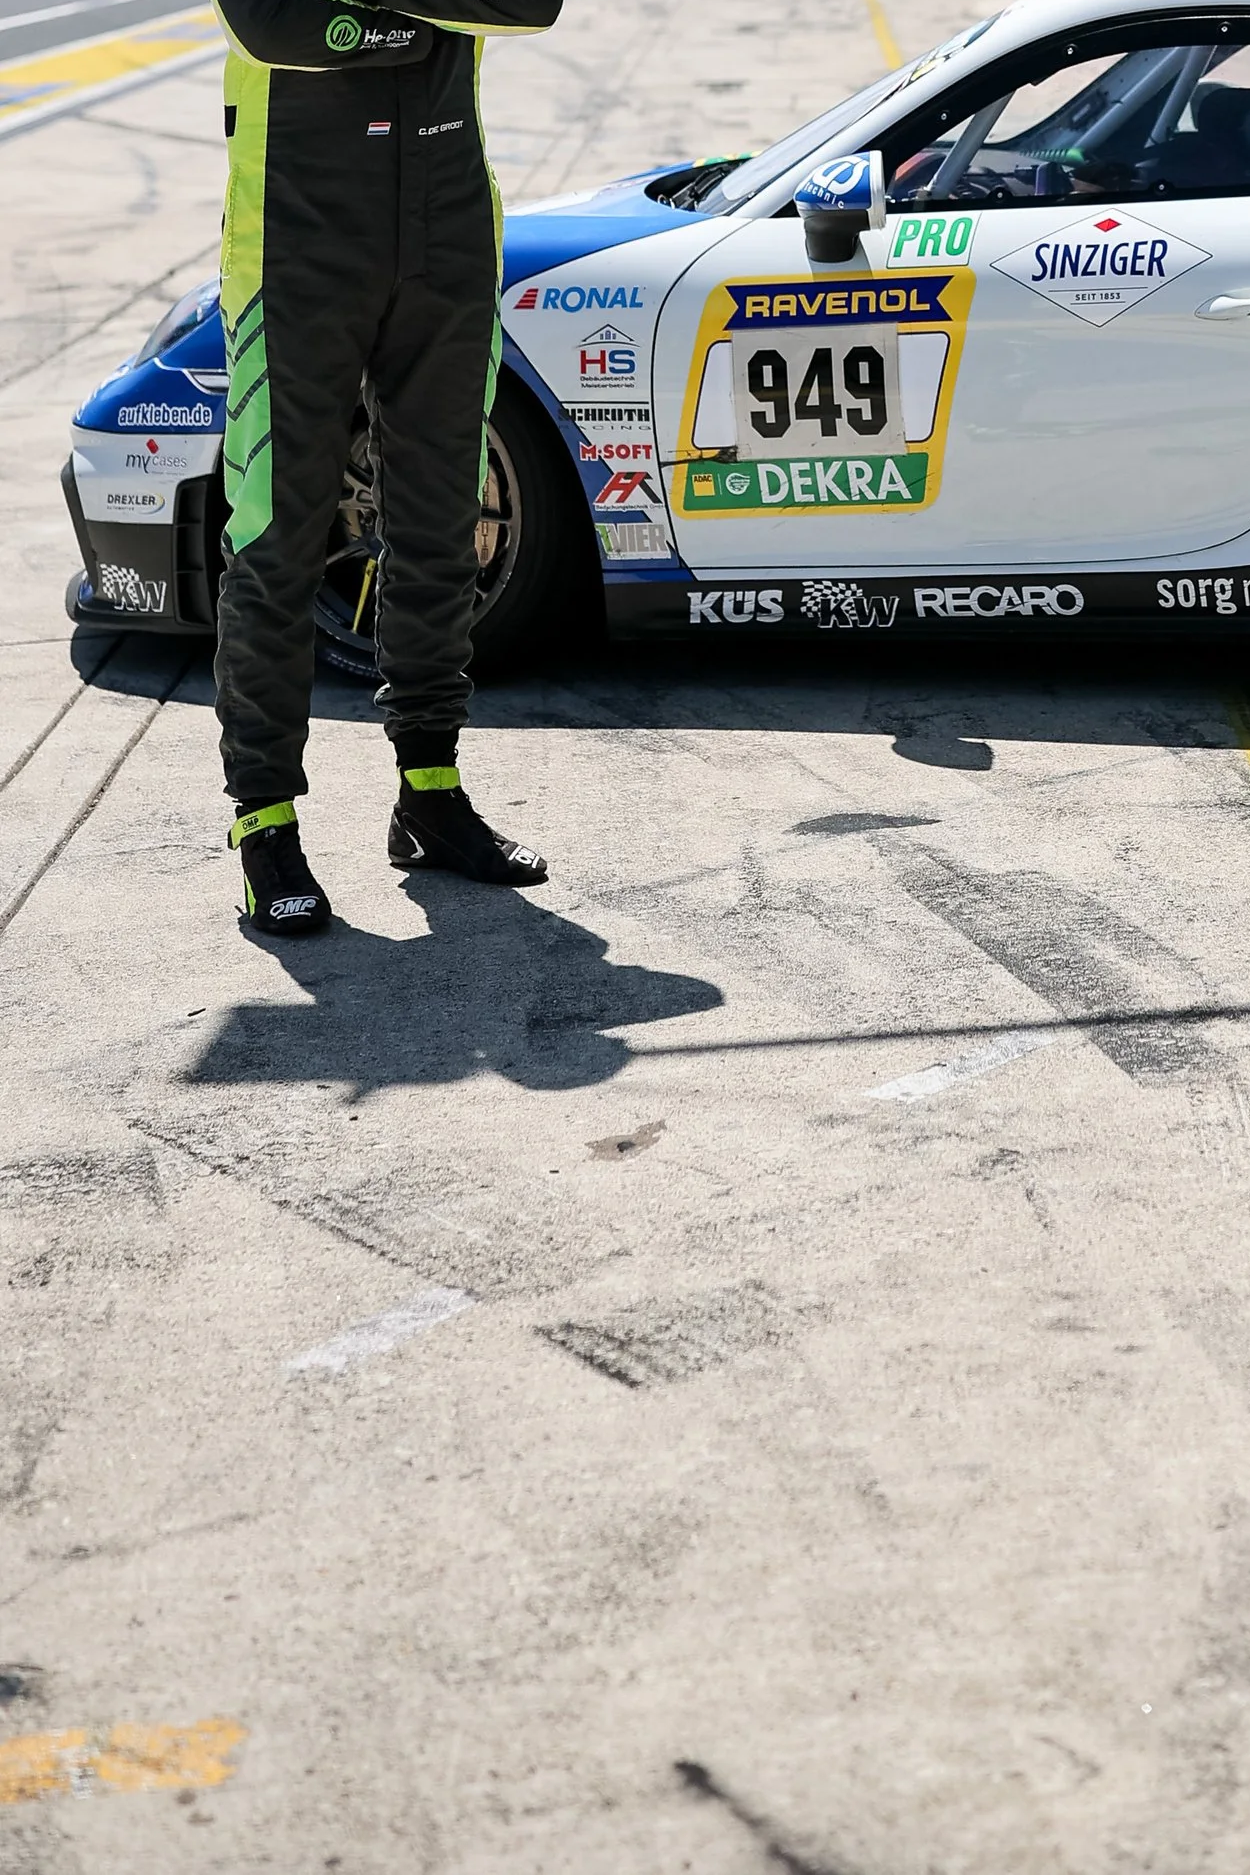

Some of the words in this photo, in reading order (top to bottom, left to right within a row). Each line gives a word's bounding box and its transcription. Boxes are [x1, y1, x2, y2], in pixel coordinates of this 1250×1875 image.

[893, 216, 973, 258] PRO
[1031, 239, 1168, 282] SINZIGER
[542, 286, 644, 313] RONAL
[745, 288, 931, 318] RAVENOL
[1075, 293, 1097, 301] SEIT
[1100, 292, 1122, 301] 1853
[580, 349, 636, 375] HS
[747, 345, 888, 439] 949
[118, 403, 212, 427] aufkleben.de
[693, 473, 712, 483] ADAC
[757, 458, 913, 504] DEKRA
[107, 493, 157, 507] DREXLER
[114, 580, 167, 613] KW
[687, 589, 784, 624] KÜS
[914, 584, 1085, 618] RECARO
[1156, 576, 1238, 615] sorg
[818, 596, 900, 629] KW
[242, 816, 260, 830] OMP
[270, 898, 318, 916] OMP
